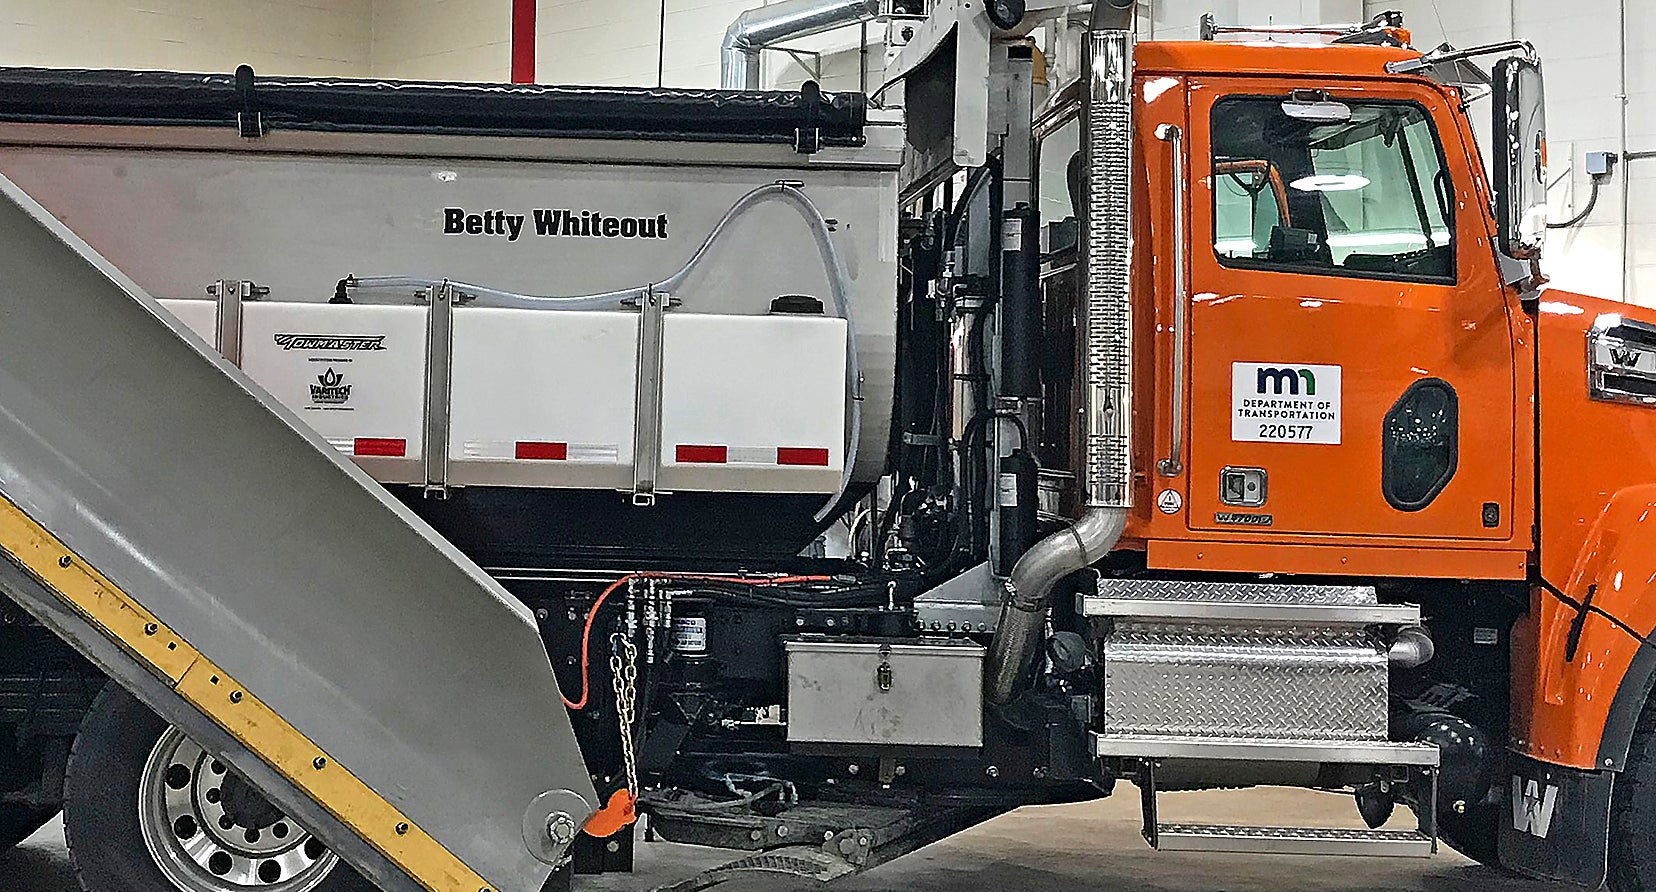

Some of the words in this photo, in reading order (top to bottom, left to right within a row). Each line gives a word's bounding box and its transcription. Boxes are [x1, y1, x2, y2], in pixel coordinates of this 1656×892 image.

[443, 207, 525, 242] Betty
[532, 209, 669, 239] Whiteout
[273, 333, 388, 351] TOWMASTER
[309, 384, 353, 396] VARITECH
[1243, 399, 1314, 410] DEPARTMENT
[1316, 401, 1332, 410] OF
[1237, 408, 1336, 421] TRANSPORTATION
[1258, 423, 1314, 440] 220577
